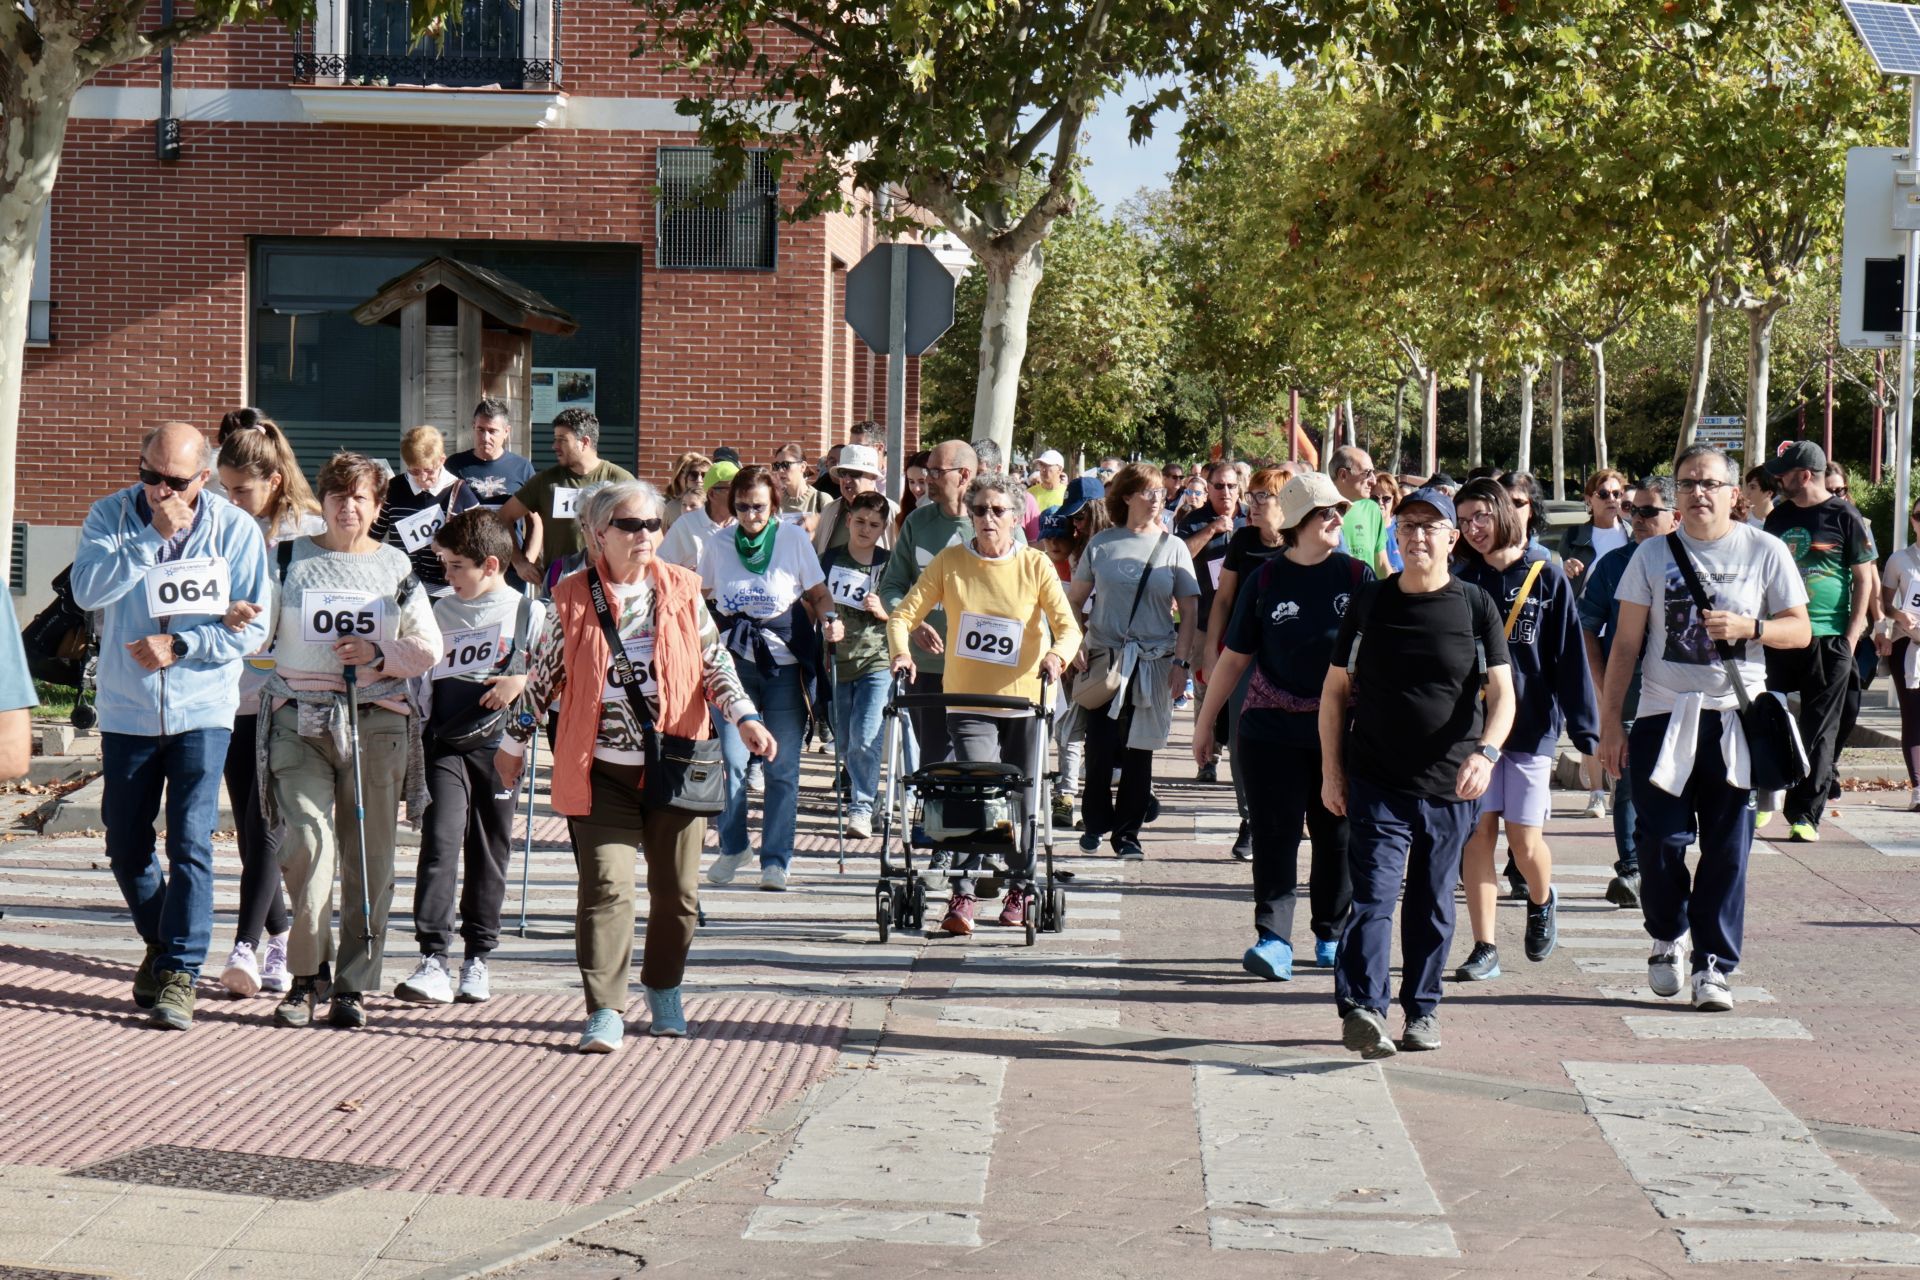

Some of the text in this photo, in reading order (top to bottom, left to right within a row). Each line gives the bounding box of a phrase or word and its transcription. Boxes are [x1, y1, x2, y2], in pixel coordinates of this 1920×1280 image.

[409, 519, 442, 542] 102
[1044, 516, 1059, 527] NY
[1710, 572, 1725, 581] GUN
[158, 579, 221, 604] 064
[591, 580, 608, 614] BIMBA
[738, 593, 780, 602] cerebral
[739, 586, 765, 595] daño
[831, 580, 866, 602] 113
[313, 609, 375, 635] 065
[446, 641, 493, 668] 106
[965, 630, 1014, 656] 029
